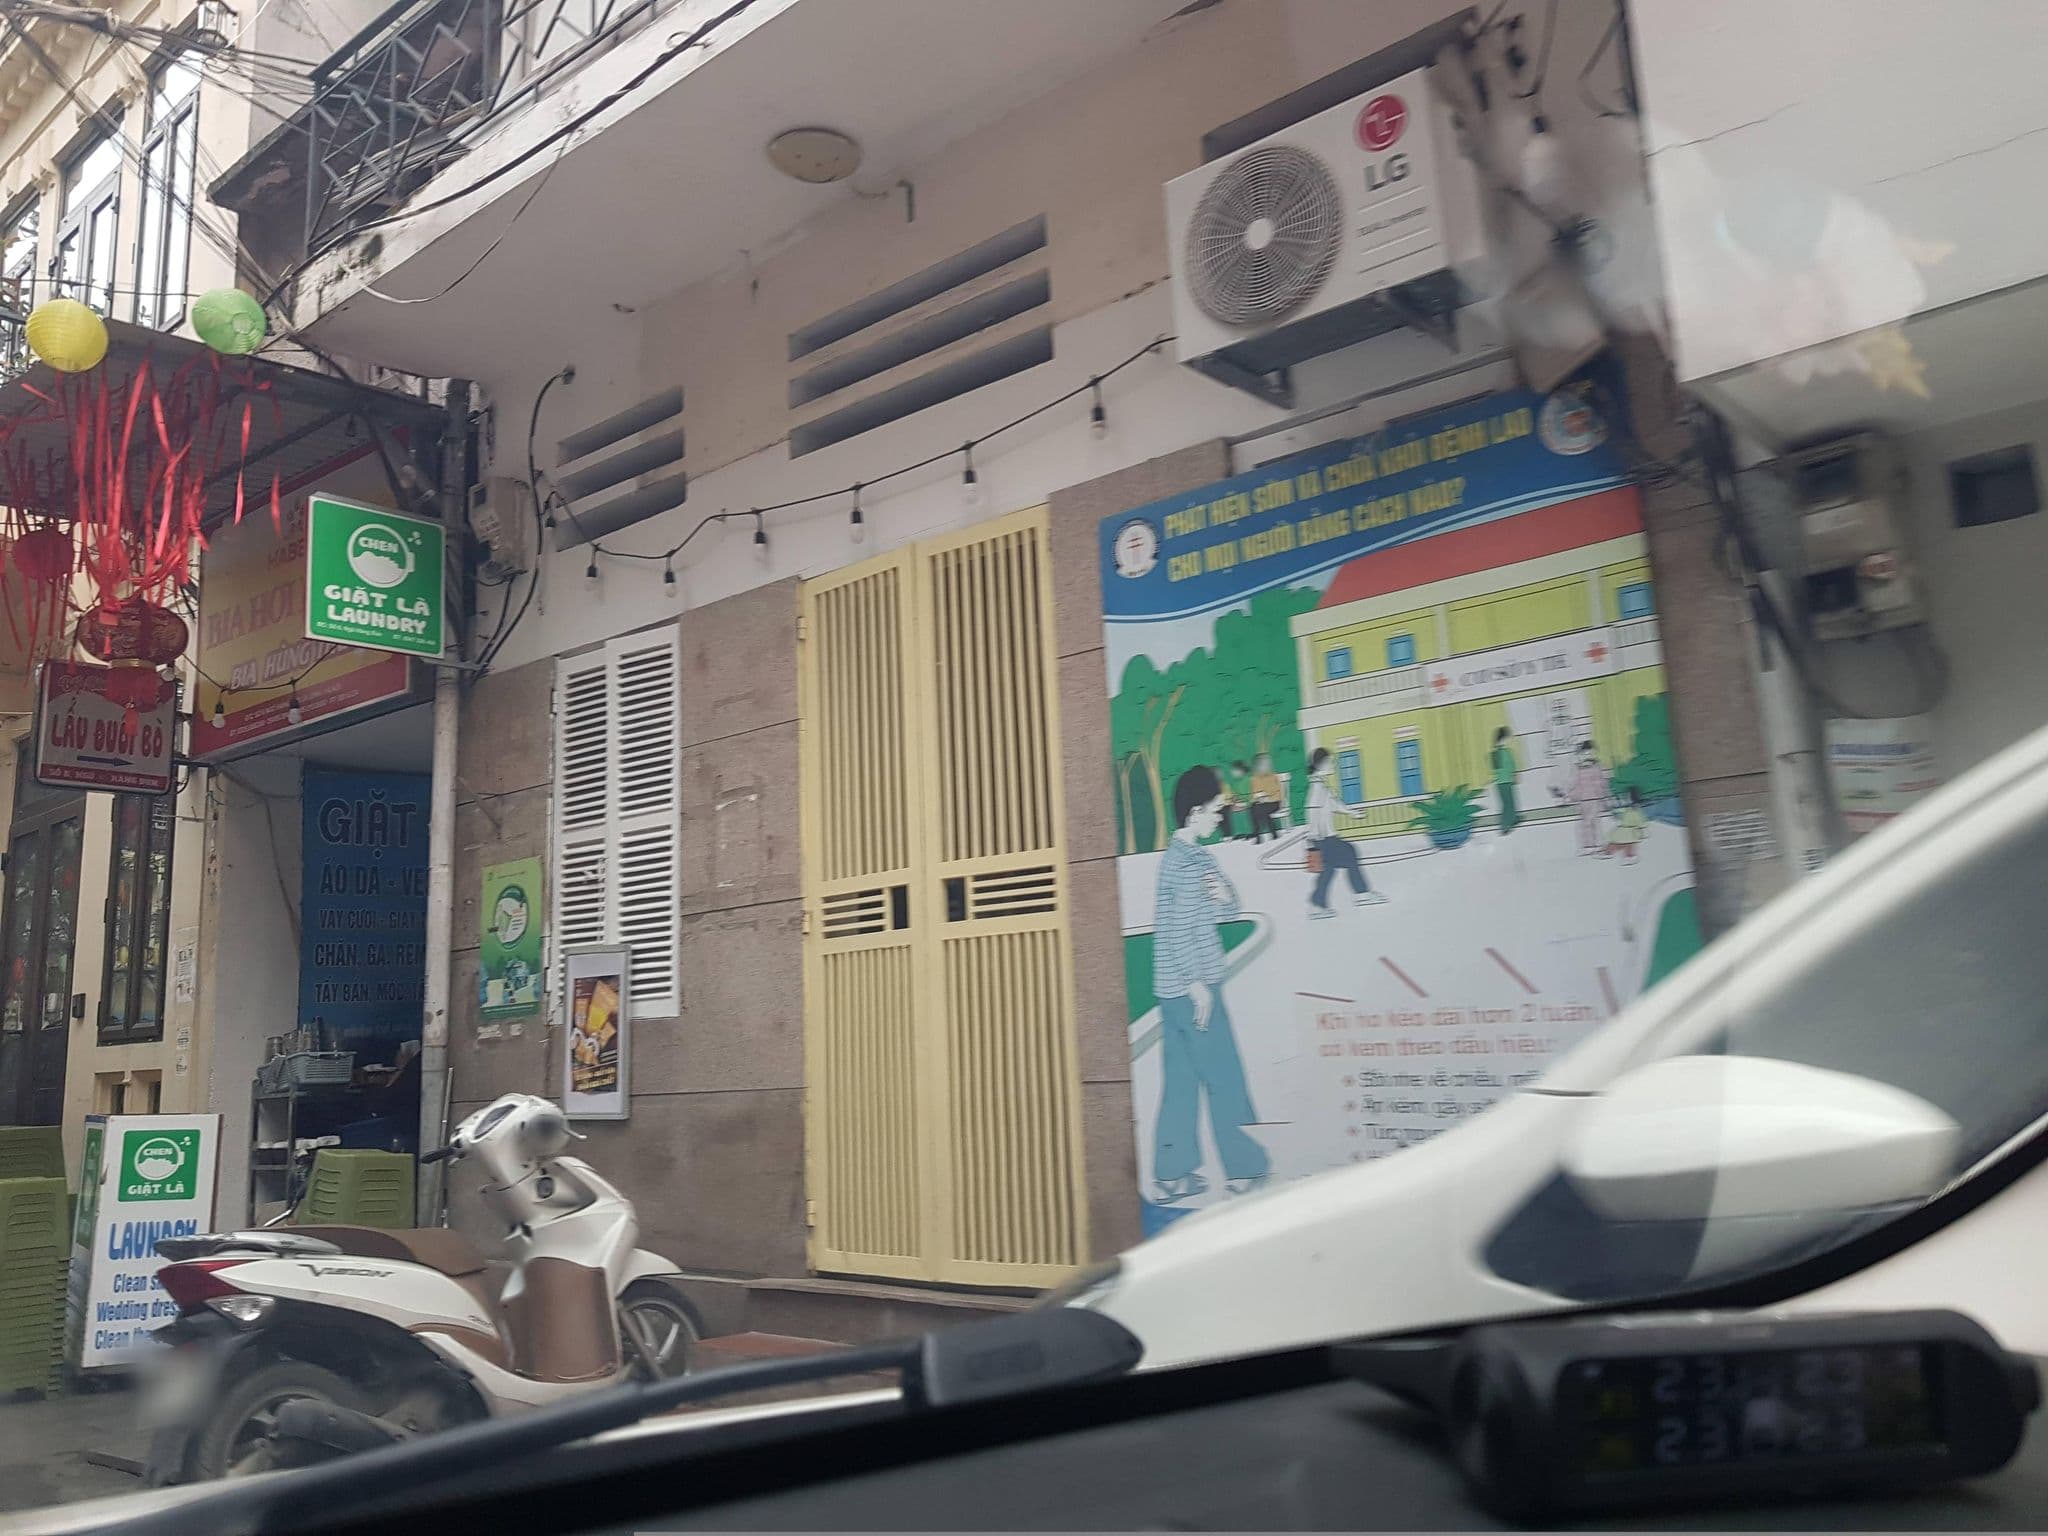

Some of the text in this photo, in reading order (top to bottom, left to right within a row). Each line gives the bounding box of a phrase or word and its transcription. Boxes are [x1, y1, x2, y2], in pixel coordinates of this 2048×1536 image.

[1363, 152, 1411, 192] LG
[1164, 502, 1207, 539] PHÁT
[1429, 425, 1489, 464] BỆNH
[1489, 407, 1533, 444] LAO
[359, 537, 399, 553] CHEN
[1167, 550, 1203, 583] CHO
[324, 585, 430, 616] GIẶT LÀ
[328, 604, 426, 634] LAUNDRY
[230, 659, 257, 690] BIA
[142, 718, 162, 757] BÒ
[318, 788, 417, 859] GIẶT
[320, 857, 348, 896] ÁO
[401, 865, 431, 897] VE
[143, 1147, 173, 1156] CHEN
[127, 1181, 184, 1196] GIẶT LÀ
[113, 1273, 147, 1293] Clean
[97, 1300, 147, 1322] Wedding
[95, 1329, 130, 1350] Clean
